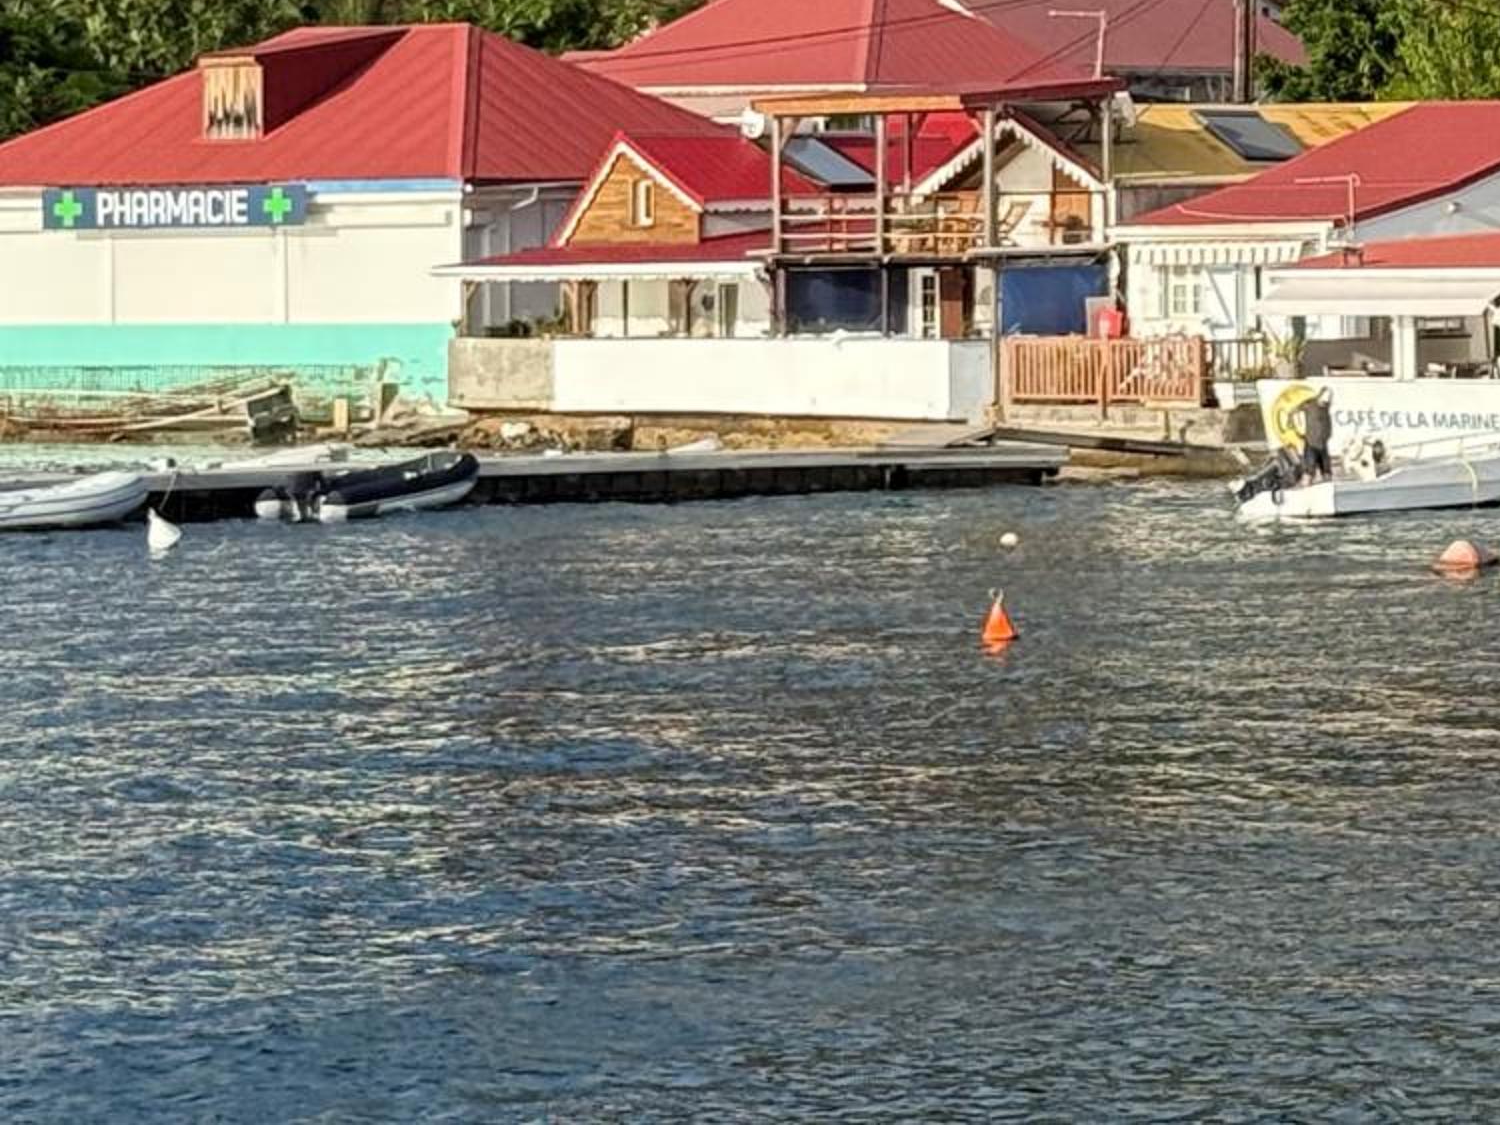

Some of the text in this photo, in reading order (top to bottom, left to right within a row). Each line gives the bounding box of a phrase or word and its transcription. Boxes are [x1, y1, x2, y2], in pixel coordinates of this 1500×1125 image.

[97, 190, 248, 225] PHARMACIE
[1379, 410, 1402, 428] DE
[1406, 411, 1429, 428] LA
[1432, 412, 1500, 430] MARINE
